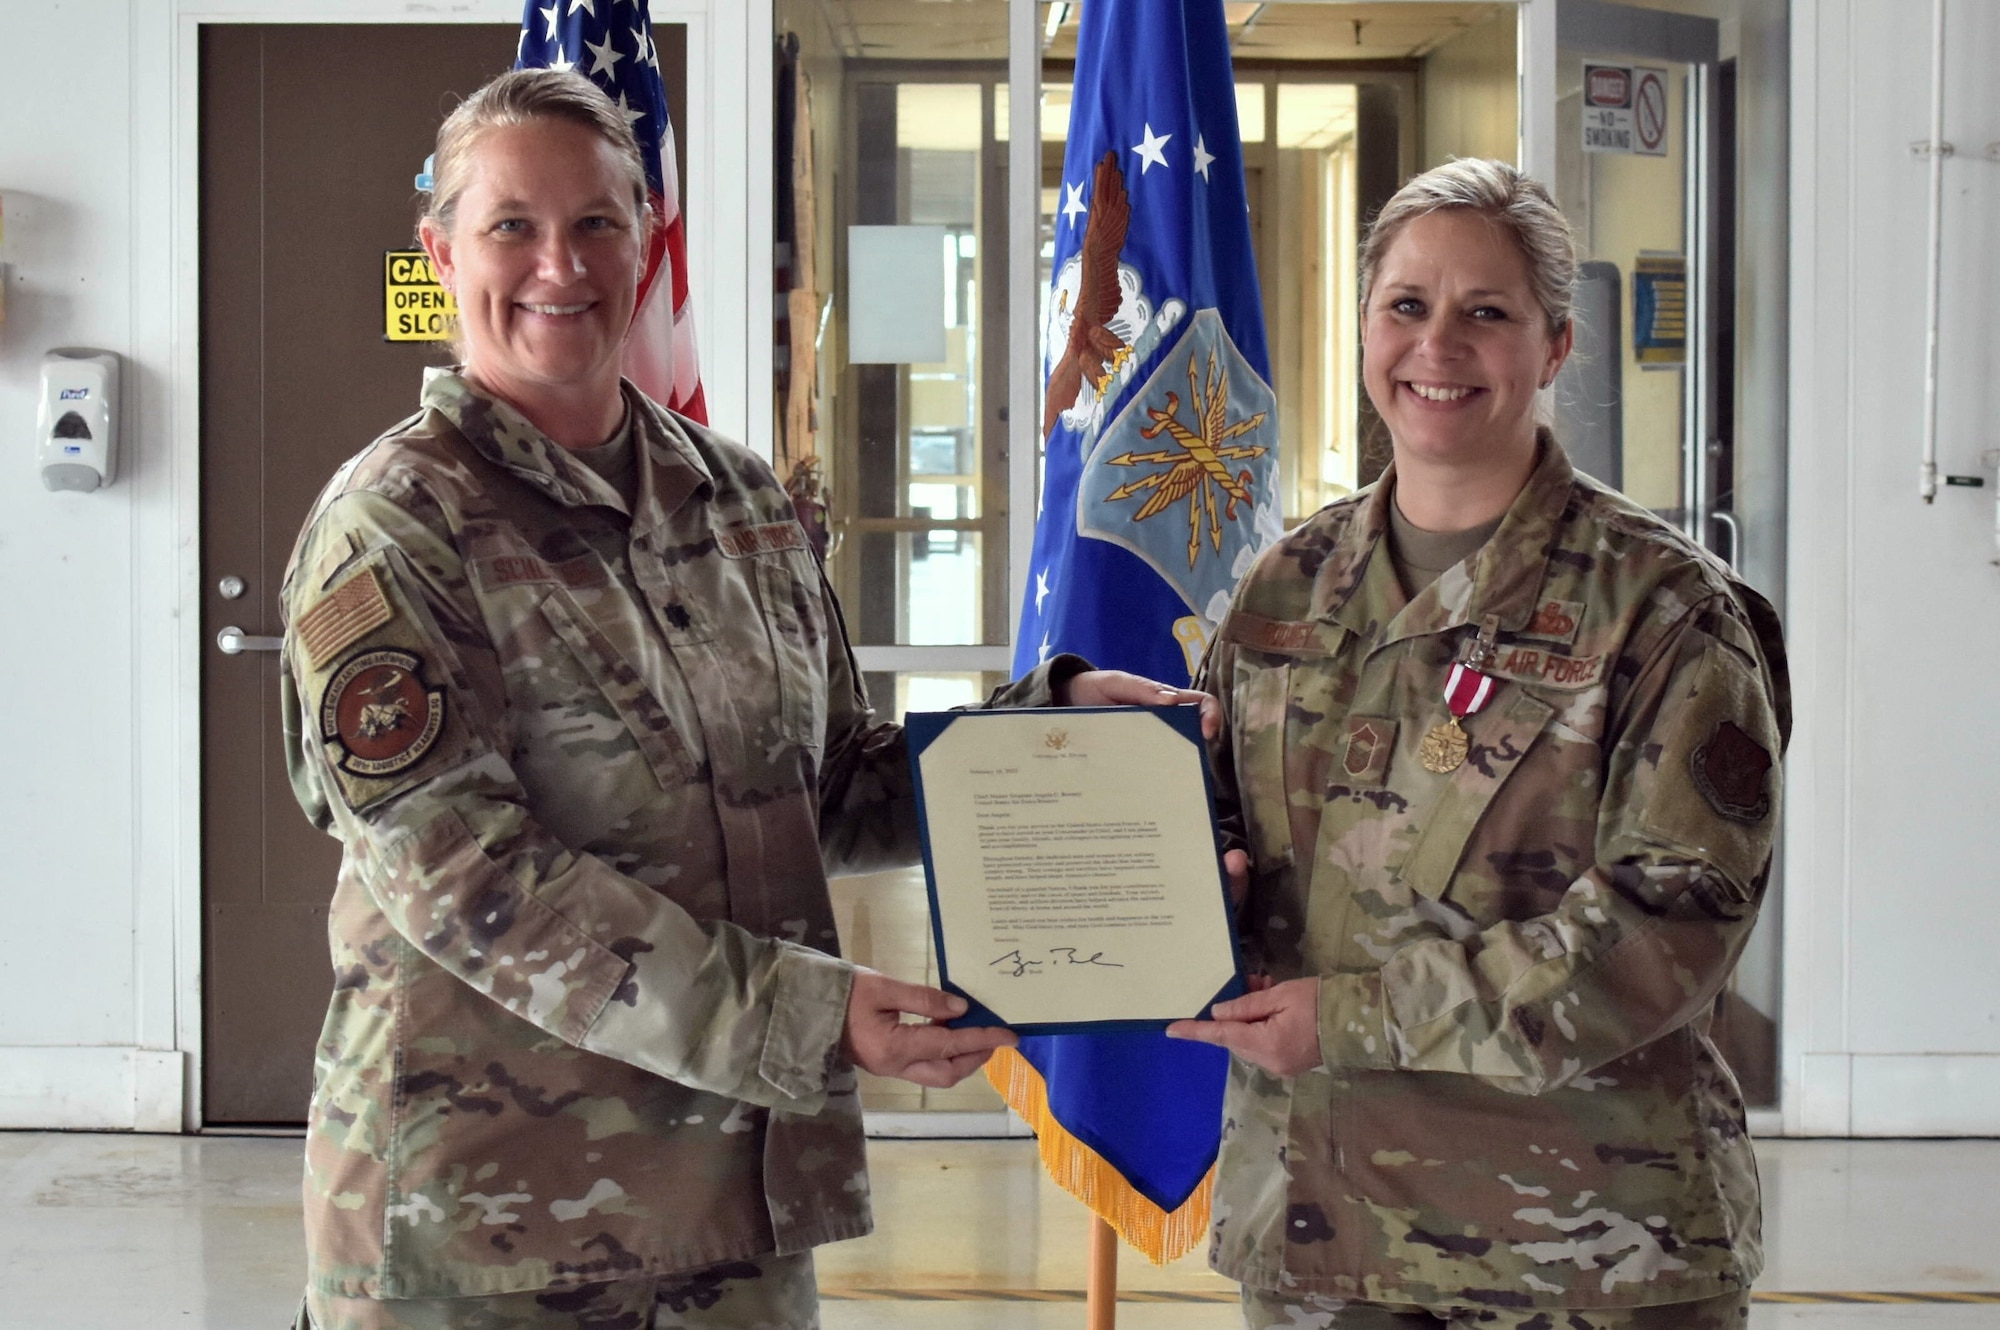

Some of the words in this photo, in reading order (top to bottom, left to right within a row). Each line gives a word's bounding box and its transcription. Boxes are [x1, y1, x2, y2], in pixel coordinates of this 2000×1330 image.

[1600, 111, 1614, 127] NO
[1586, 127, 1630, 149] SMOKING
[394, 291, 445, 309] OPEN
[1504, 649, 1539, 673] AIR
[1541, 654, 1601, 683] FORCE
